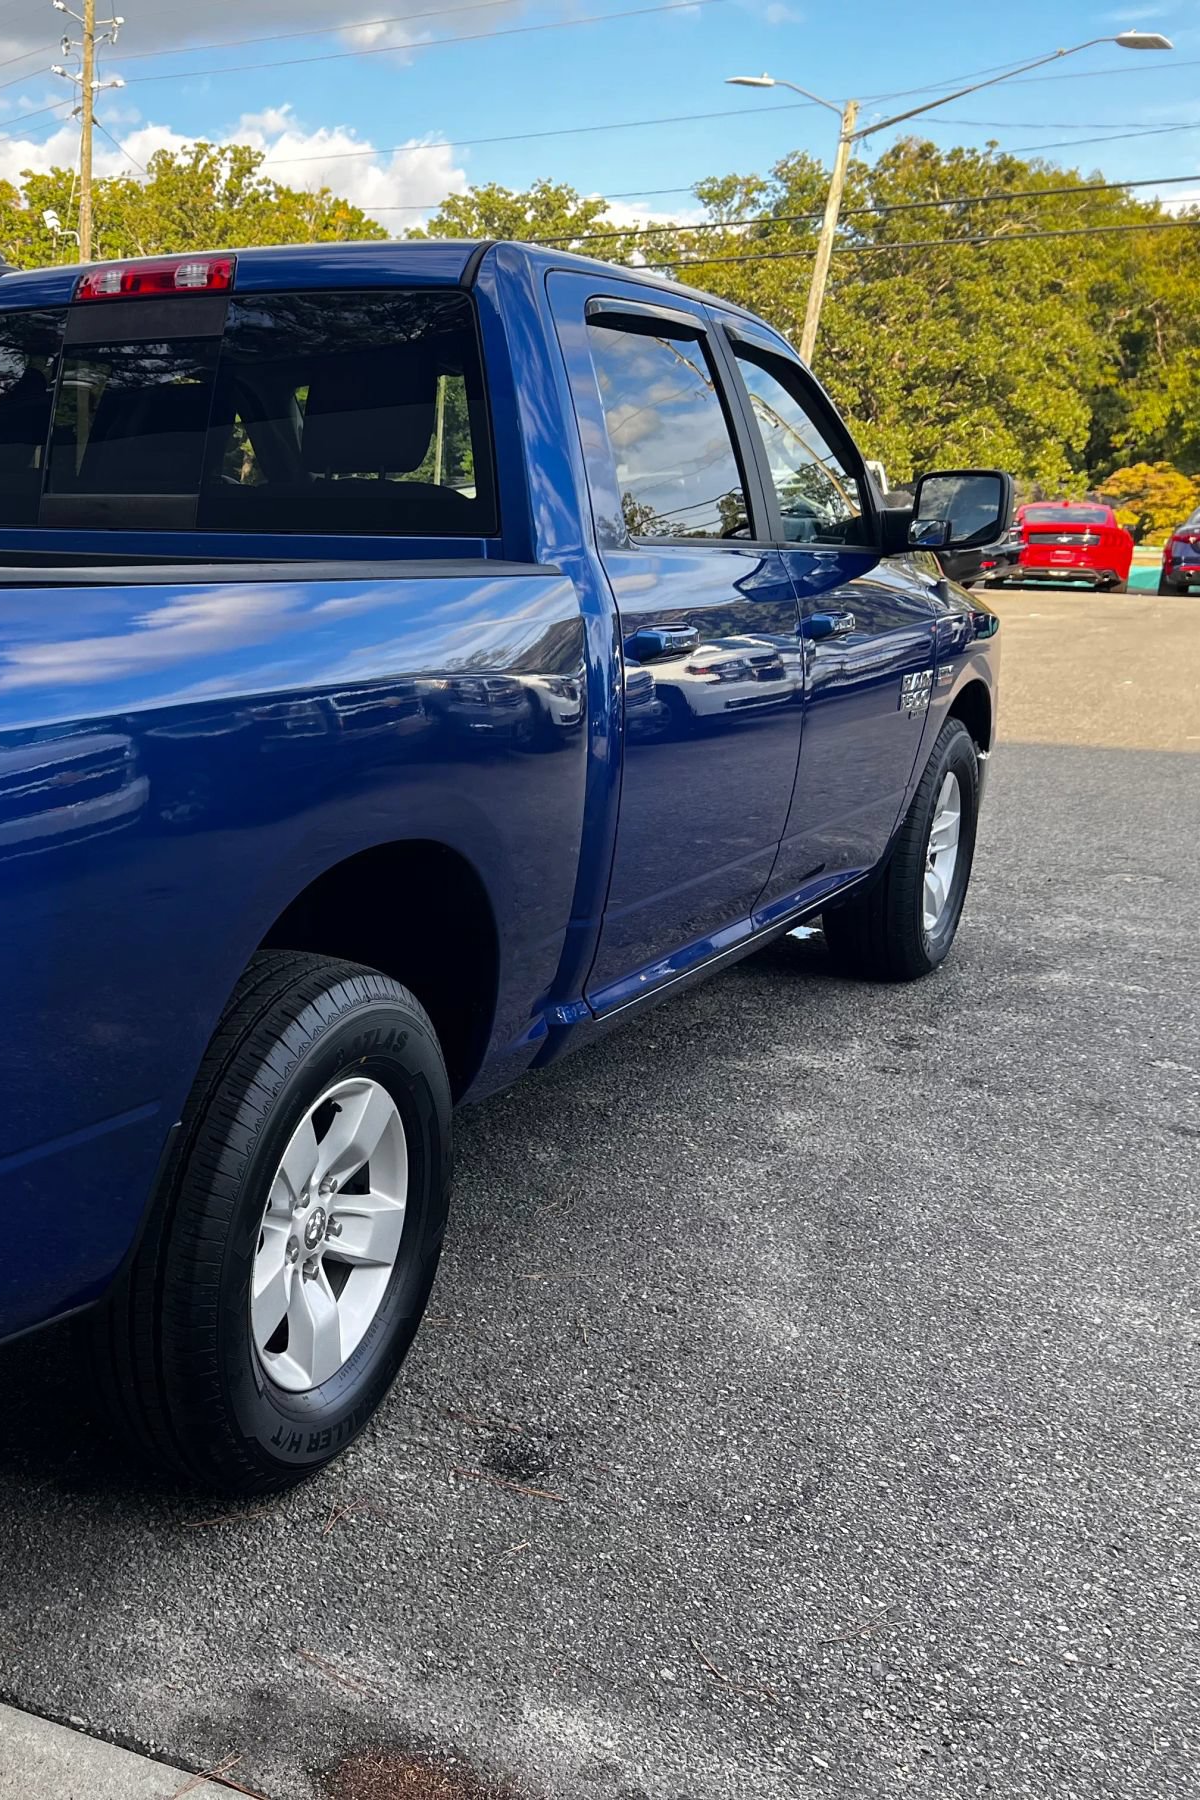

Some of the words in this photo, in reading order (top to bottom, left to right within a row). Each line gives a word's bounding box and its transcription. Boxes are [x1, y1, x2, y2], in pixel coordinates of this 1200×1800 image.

[901, 689, 929, 711] 1500
[351, 1026, 408, 1054] ATLAS
[270, 1425, 302, 1454] H/T
